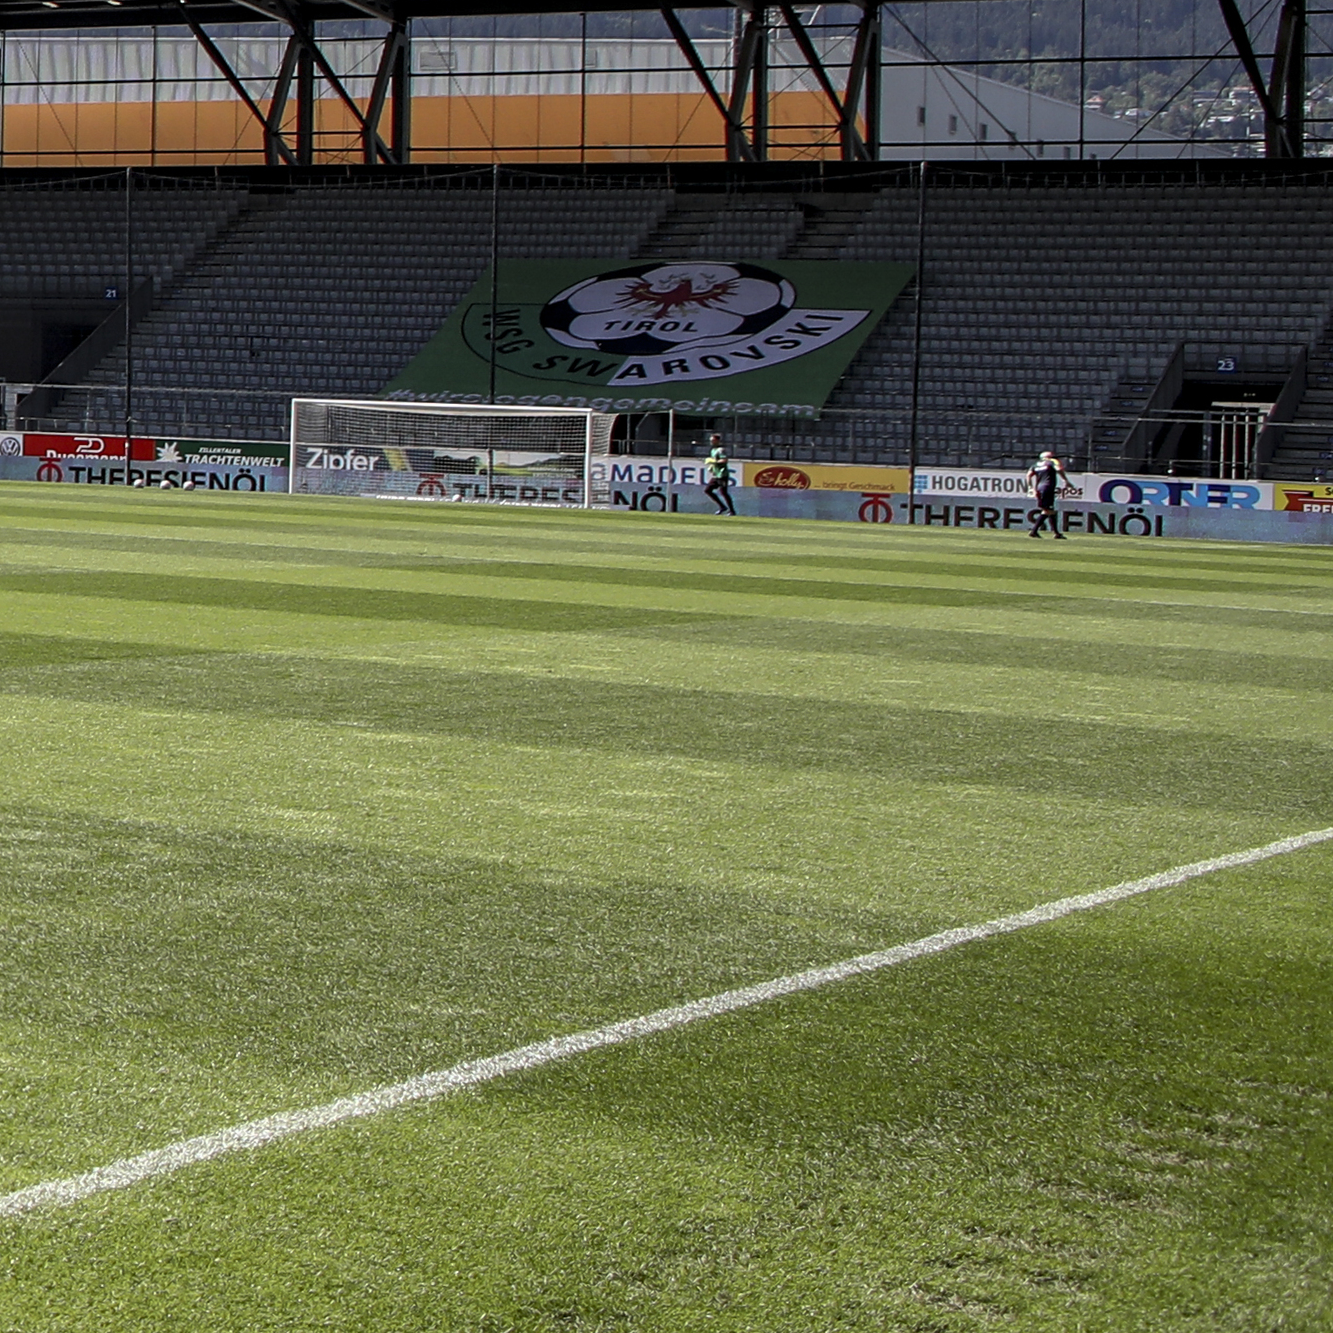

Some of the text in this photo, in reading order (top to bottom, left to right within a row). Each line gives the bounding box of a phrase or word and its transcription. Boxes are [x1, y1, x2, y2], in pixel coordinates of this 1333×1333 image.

[105, 289, 117, 298] 21
[604, 319, 699, 333] TIROL
[483, 308, 844, 381] WSG SWAROVSKI
[1217, 359, 1235, 371] 23
[184, 453, 286, 468] TRACHTENWELT
[305, 447, 380, 471] Zipfer
[848, 481, 895, 491] Geschmack
[931, 475, 1029, 494] HOGATRON
[1099, 479, 1261, 510] ORTNER
